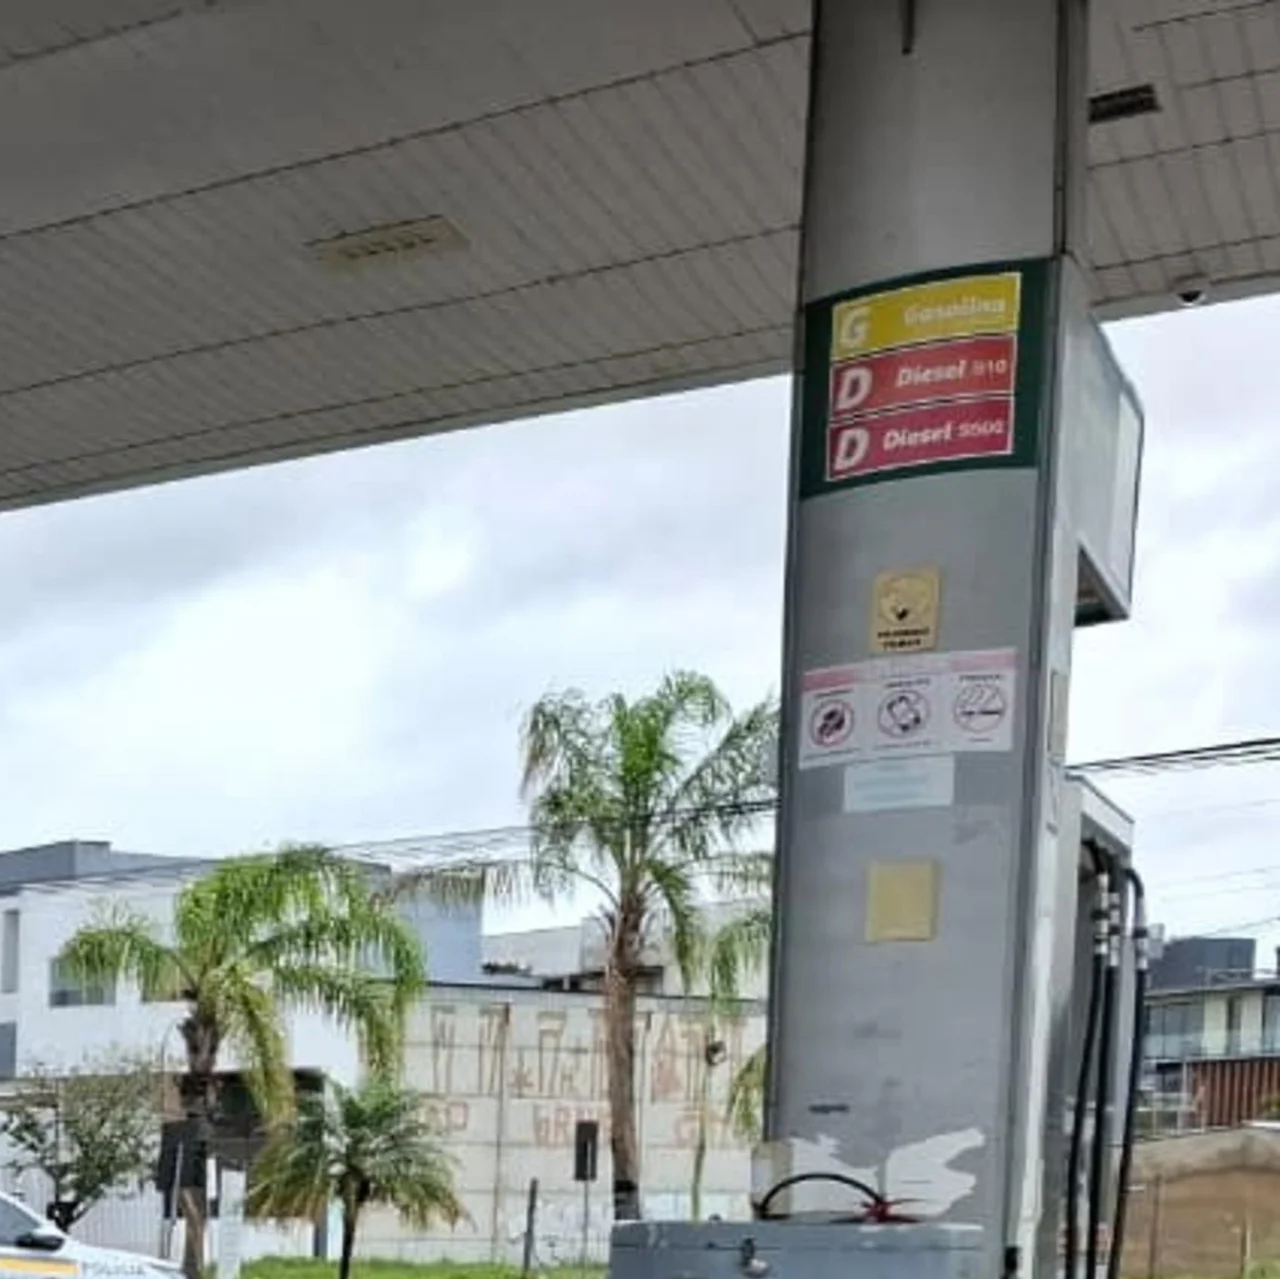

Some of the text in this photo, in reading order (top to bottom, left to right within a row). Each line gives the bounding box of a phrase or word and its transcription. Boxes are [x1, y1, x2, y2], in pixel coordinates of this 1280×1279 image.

[841, 306, 870, 347] G
[837, 366, 873, 410] D
[896, 359, 968, 388] Diesel
[834, 427, 870, 471] D
[883, 423, 953, 451] Diesel
